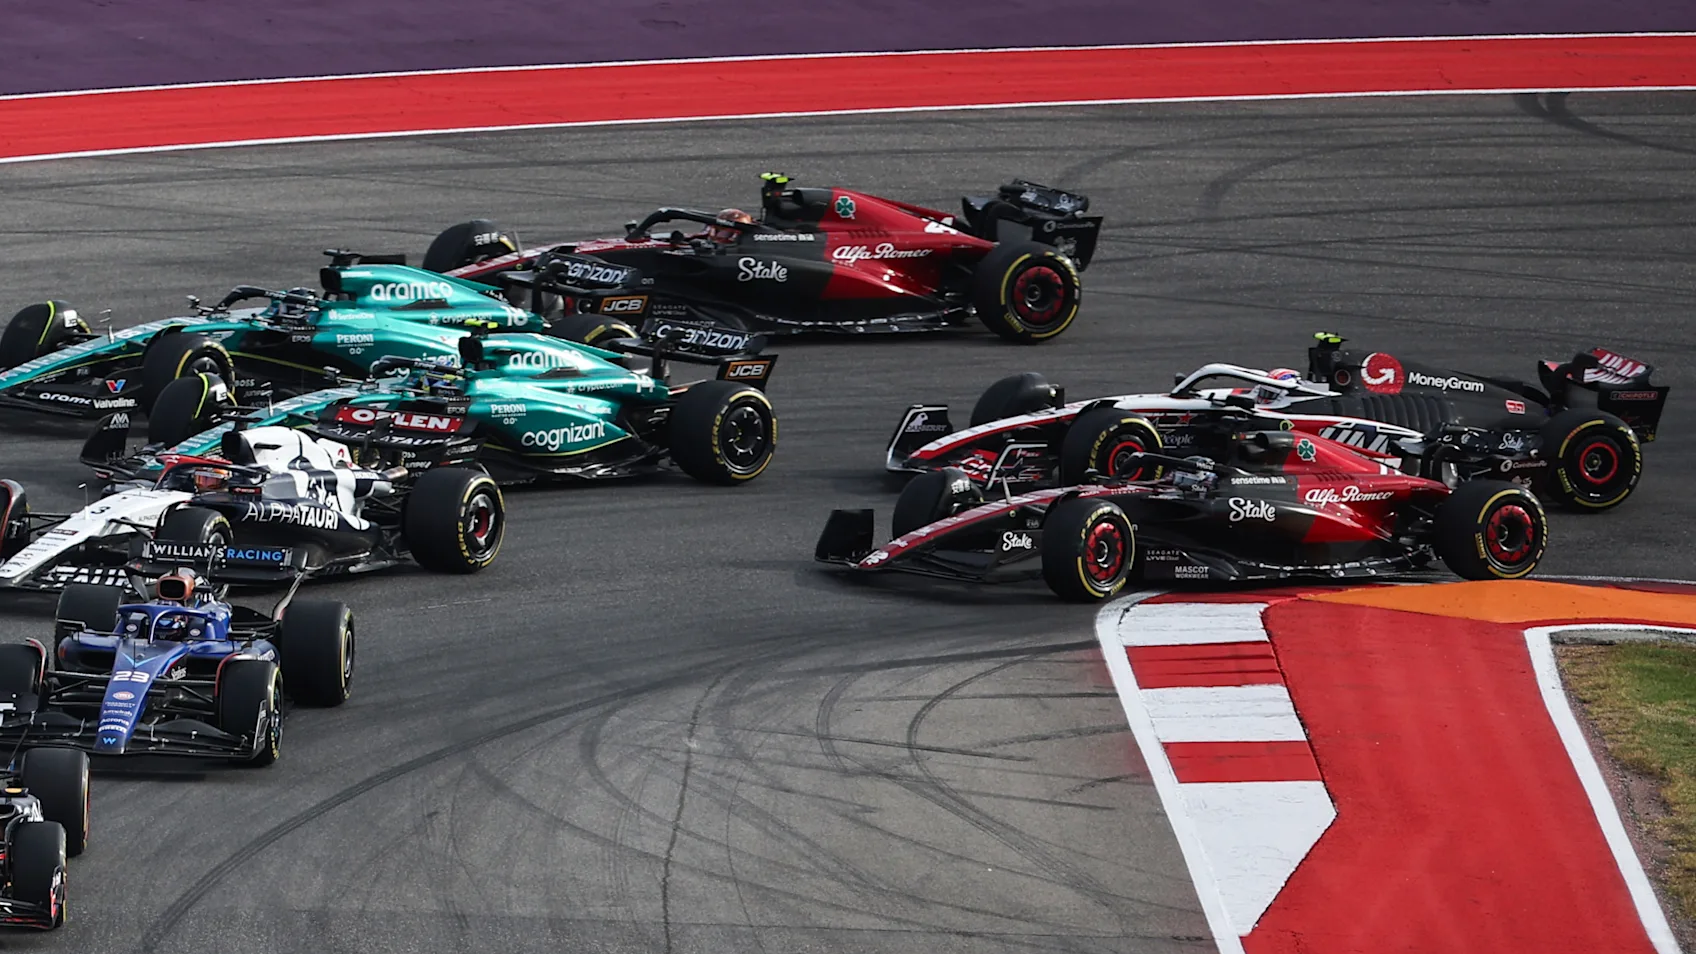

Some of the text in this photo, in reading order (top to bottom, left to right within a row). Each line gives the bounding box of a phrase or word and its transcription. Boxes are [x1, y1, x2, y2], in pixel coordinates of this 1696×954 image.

[833, 242, 933, 262] Alfa Romeo
[738, 257, 789, 282] Stake
[371, 282, 453, 300] aramco
[605, 299, 642, 311] JCB
[337, 334, 374, 343] PERONI
[730, 365, 764, 377] JCB
[1408, 371, 1484, 392] MoneyGram
[93, 398, 135, 409] Valvoline
[491, 404, 526, 414] PERONI
[351, 409, 451, 430] OLEN
[521, 421, 607, 451] cognizant
[1305, 486, 1395, 504] Alfa Romeo
[242, 502, 339, 530] ALPHATAURI
[1229, 497, 1277, 522] Stake
[1002, 532, 1032, 551] Stake
[226, 547, 284, 562] RACING
[113, 670, 150, 683] 23
